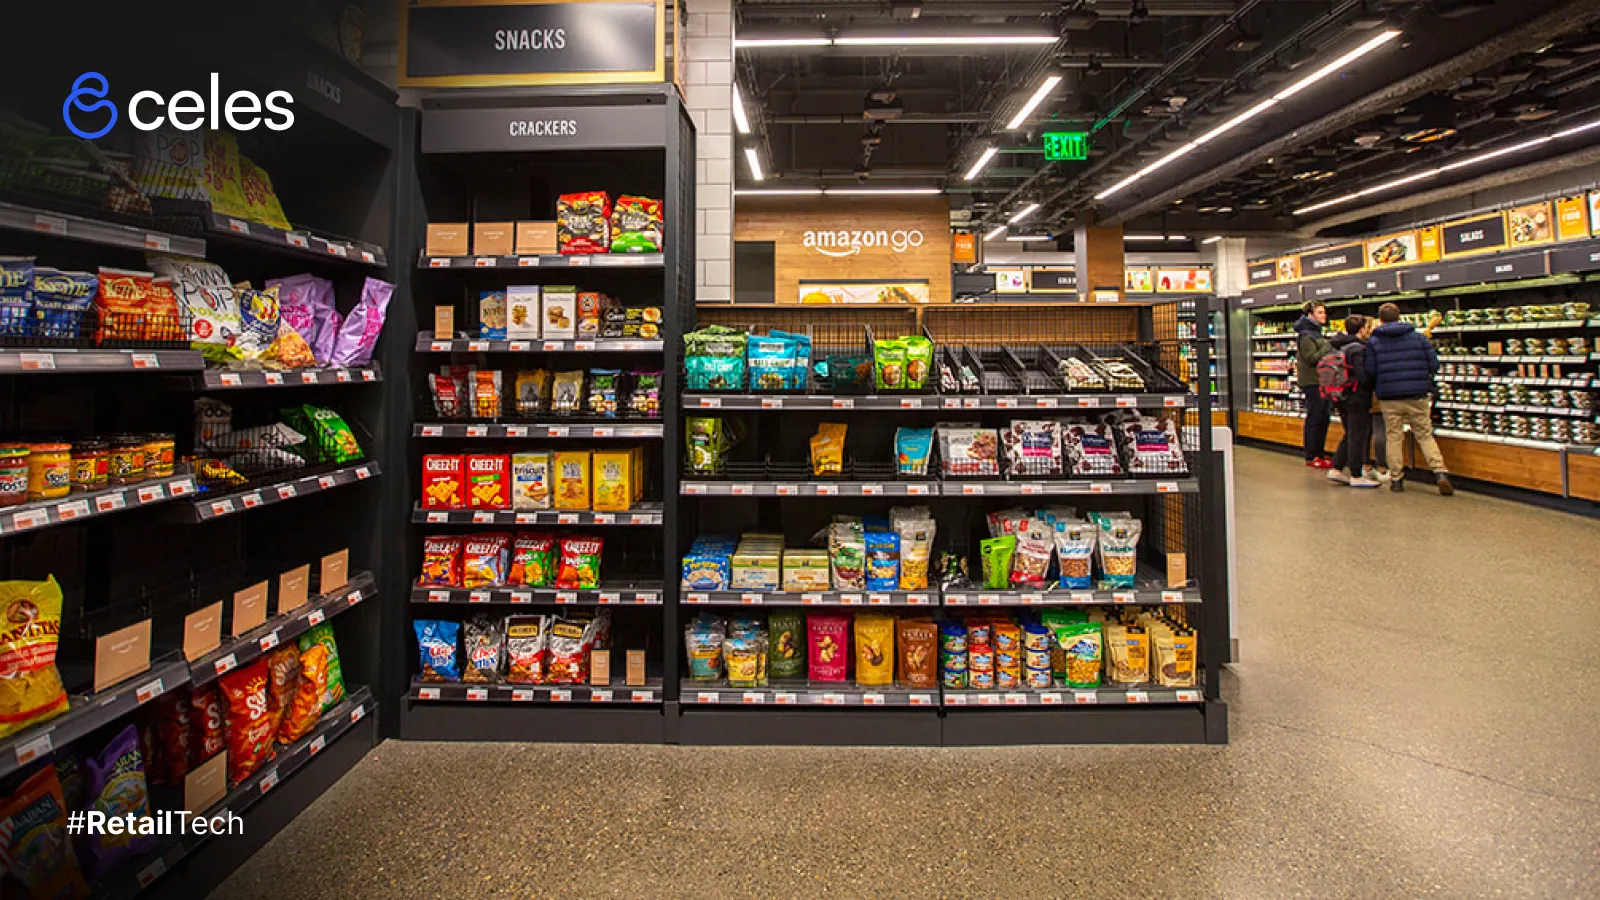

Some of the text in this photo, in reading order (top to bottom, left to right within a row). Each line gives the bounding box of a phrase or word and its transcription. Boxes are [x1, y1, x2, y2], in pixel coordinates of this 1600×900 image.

[495, 28, 567, 51] SNACKS
[306, 70, 343, 105] SNACKS
[509, 119, 577, 137] CRACKERS
[1051, 136, 1082, 157] EXIT
[803, 230, 924, 253] amazon go
[1460, 229, 1484, 243] SALADS
[426, 458, 460, 471] CHEEZ-IT
[470, 458, 504, 471] CHEEZ-IT
